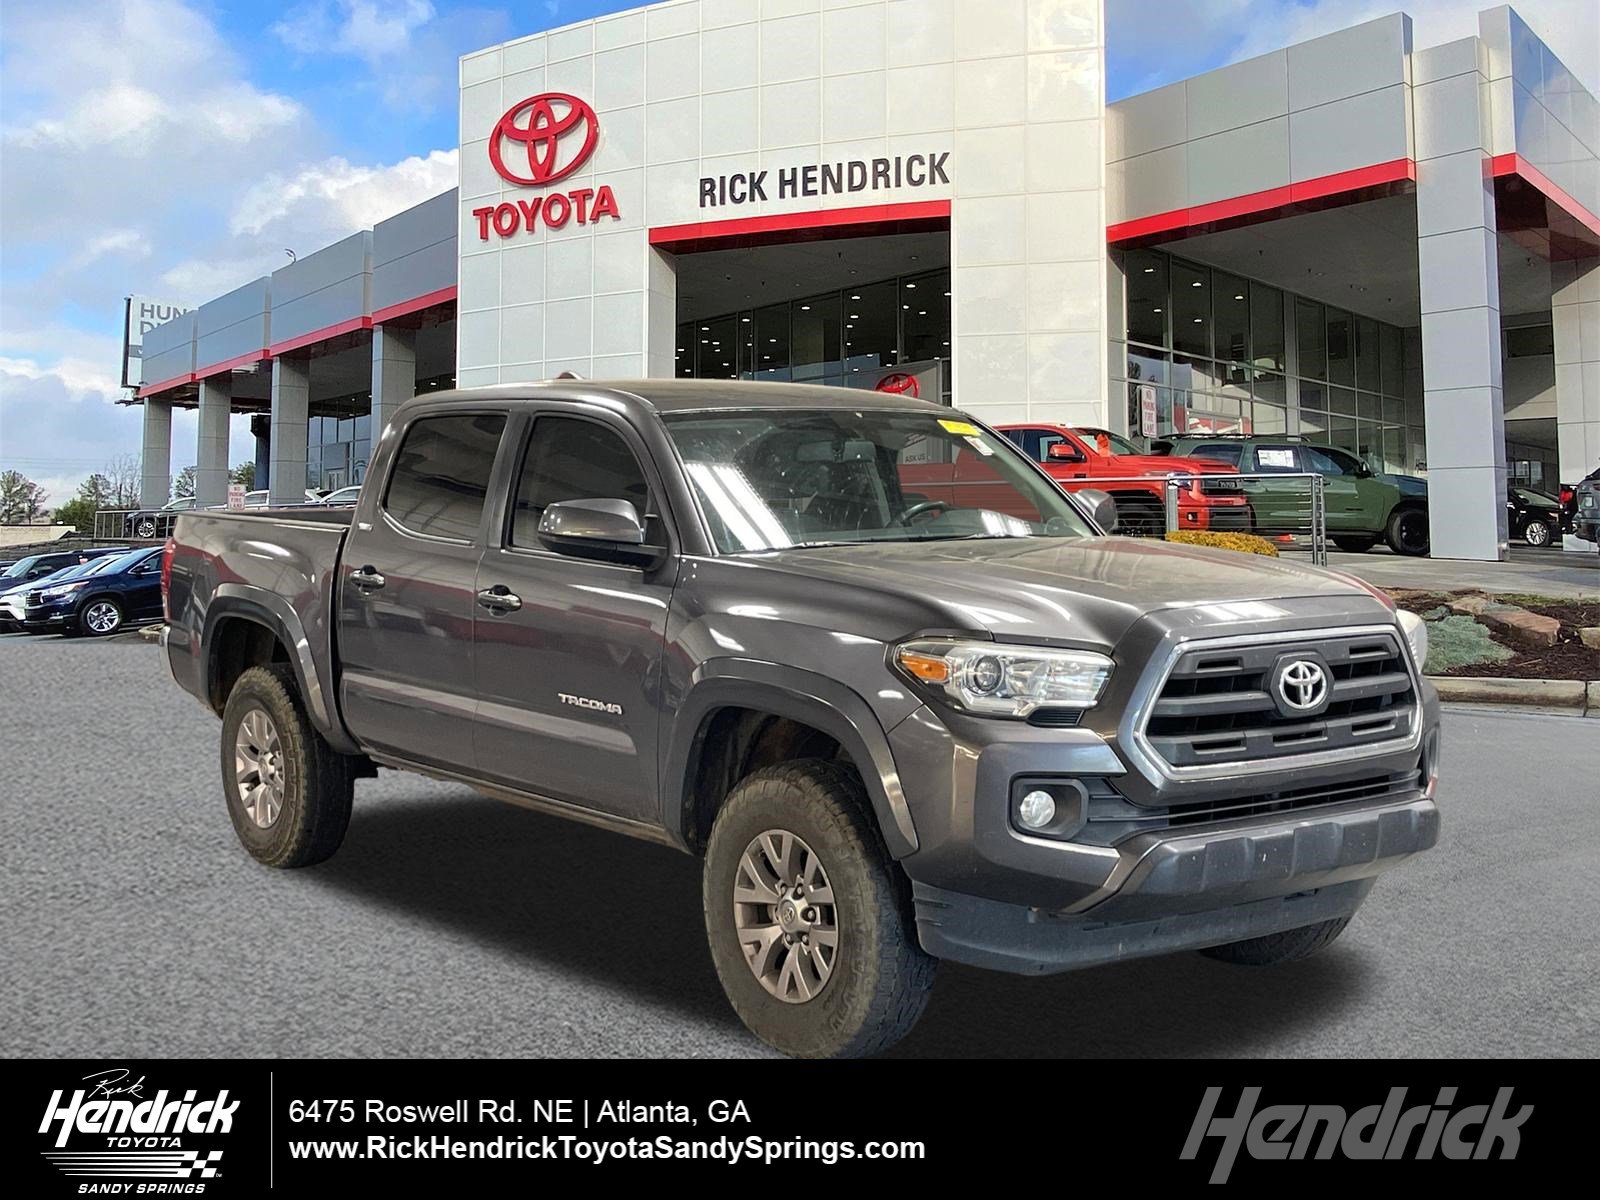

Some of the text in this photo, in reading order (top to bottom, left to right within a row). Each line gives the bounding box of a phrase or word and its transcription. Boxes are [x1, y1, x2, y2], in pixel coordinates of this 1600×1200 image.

[699, 152, 951, 208] RICK HENDRICK
[472, 185, 621, 240] TOYOTA
[558, 692, 622, 715] TACOMA
